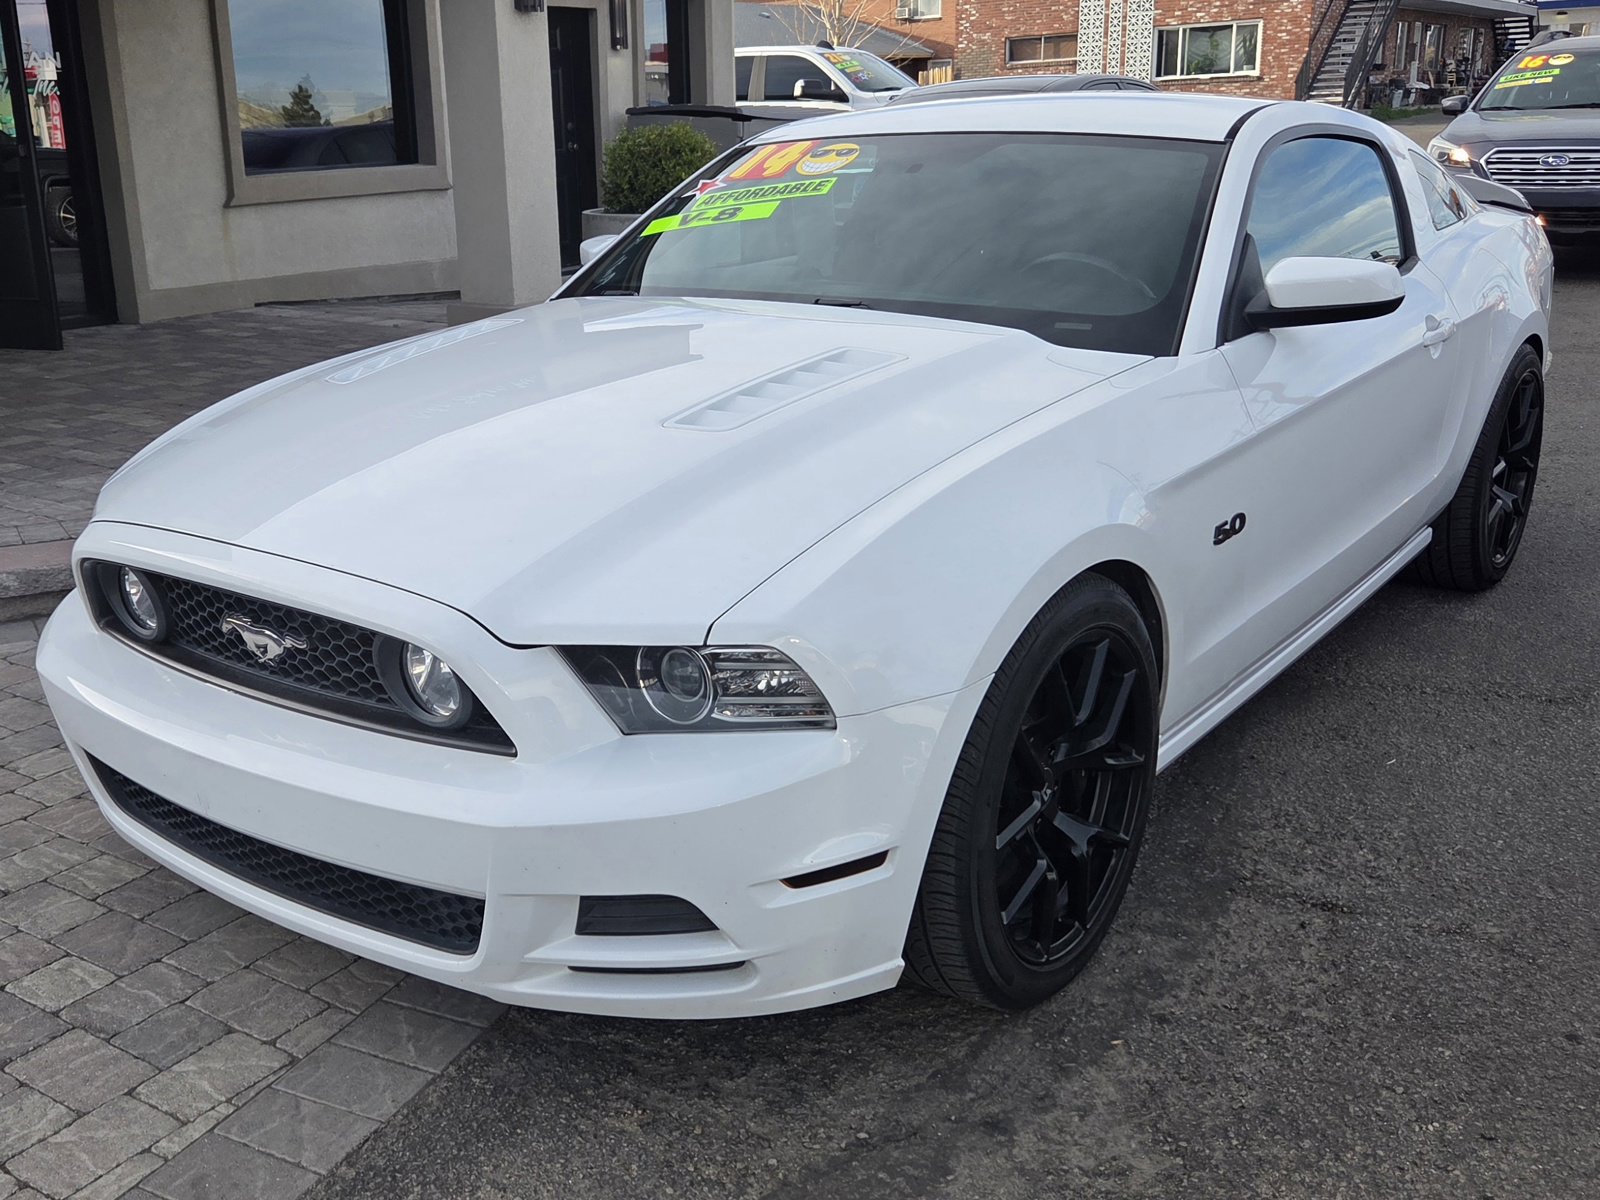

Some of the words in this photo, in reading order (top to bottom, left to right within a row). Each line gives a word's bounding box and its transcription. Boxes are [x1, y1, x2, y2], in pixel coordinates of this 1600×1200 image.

[1517, 56, 1548, 69] 16
[1529, 69, 1554, 77] NEW
[728, 140, 814, 179] 14
[701, 179, 830, 206] AFFORDABLE
[678, 206, 744, 227] V-8
